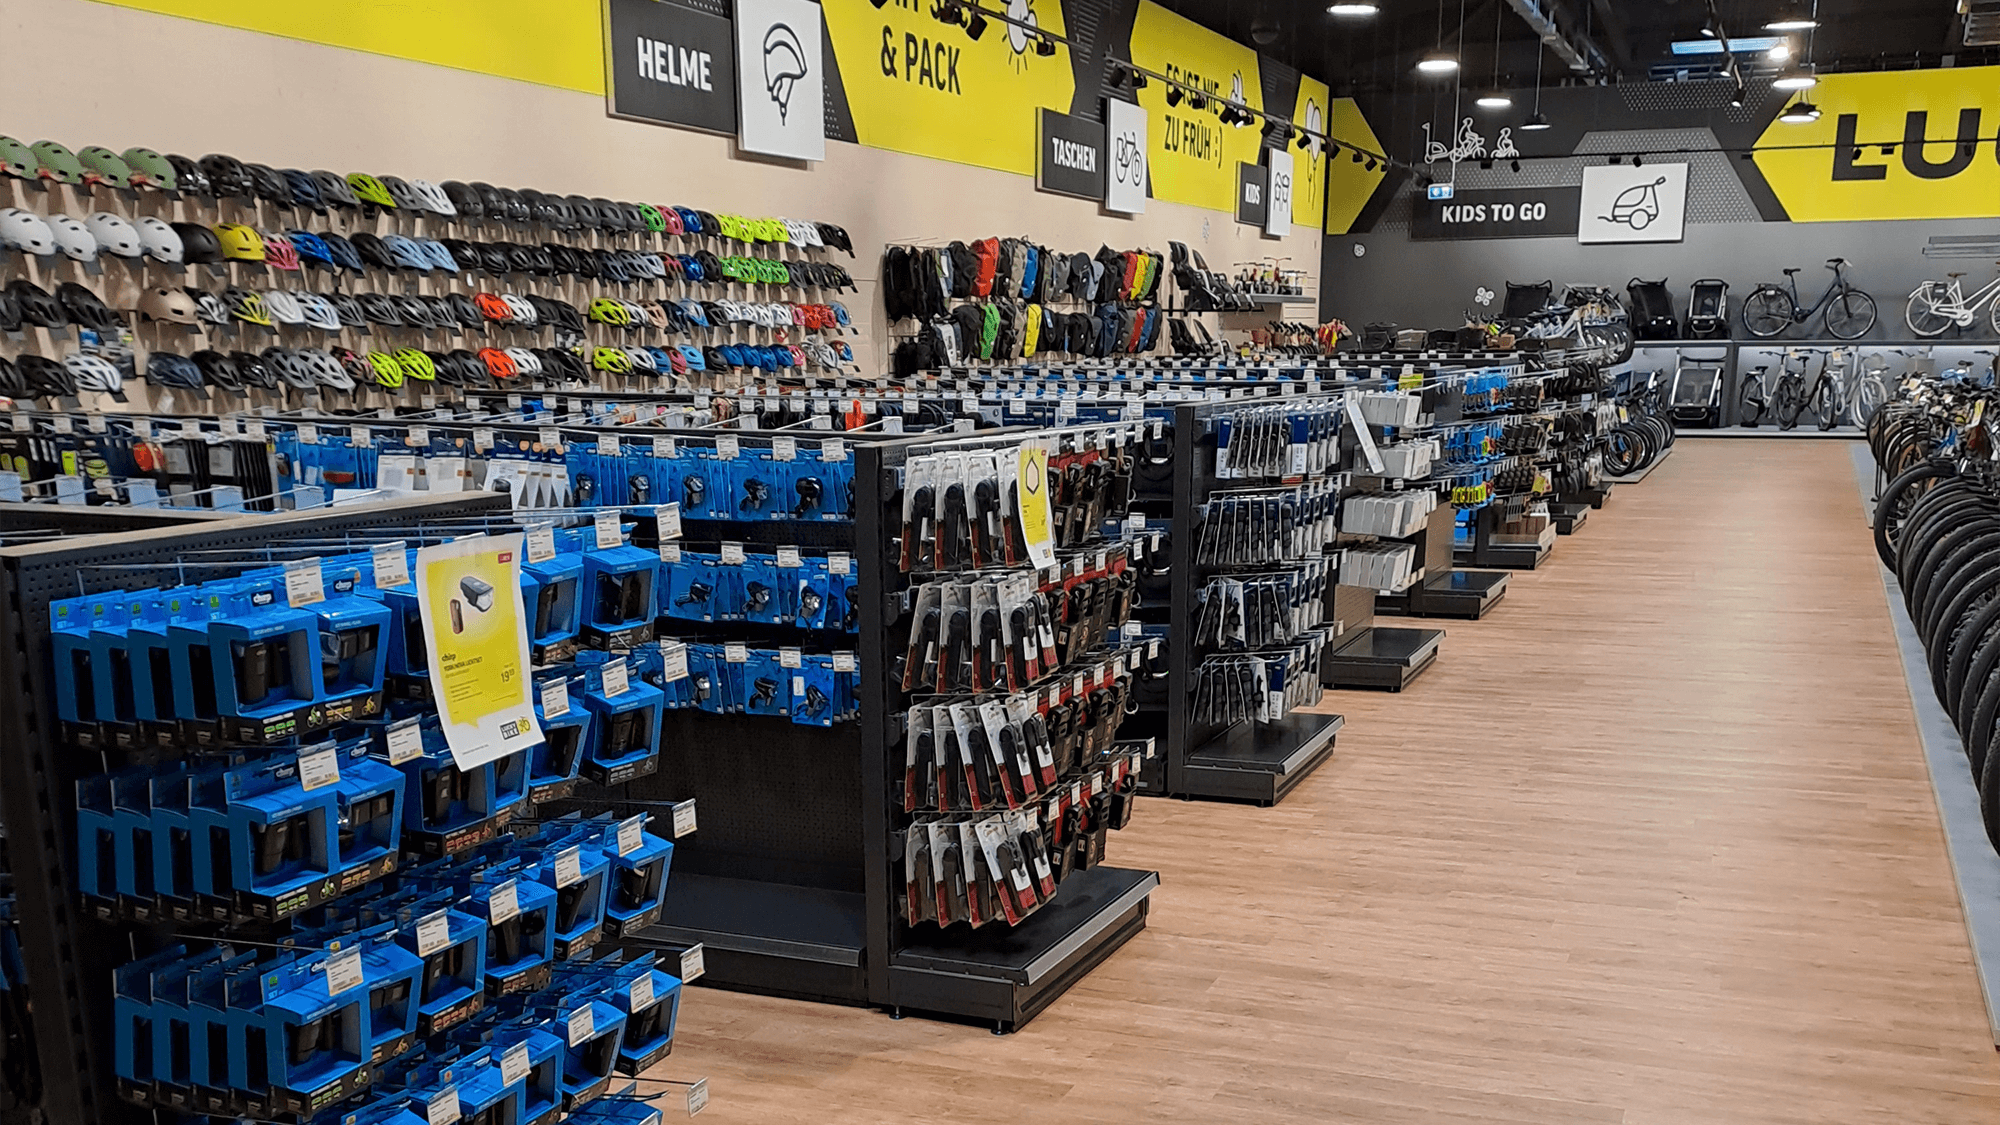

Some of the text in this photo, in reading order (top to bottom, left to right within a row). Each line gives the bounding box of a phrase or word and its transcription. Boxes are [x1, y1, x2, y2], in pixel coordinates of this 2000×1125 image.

[637, 36, 713, 92] HELME
[881, 25, 961, 95] & PACK
[1052, 137, 1096, 173] TASCHEN
[1164, 114, 1180, 152] ZU
[1183, 118, 1211, 161] FRÜH
[1832, 107, 2000, 182] LU
[1245, 182, 1260, 205] KIDS
[1442, 202, 1547, 223] KIDS TO GO
